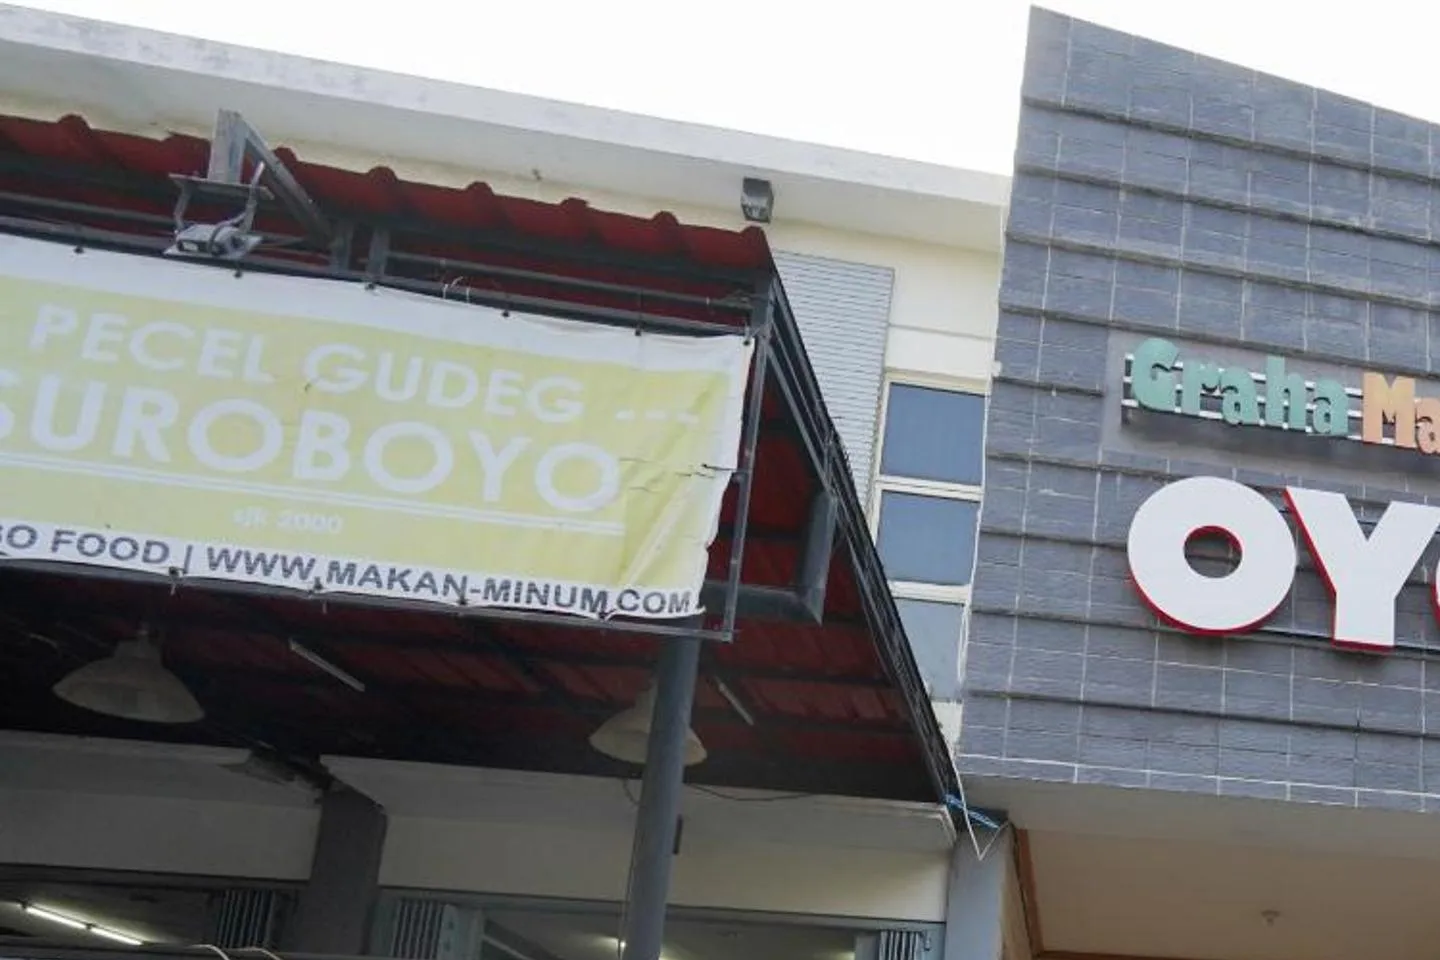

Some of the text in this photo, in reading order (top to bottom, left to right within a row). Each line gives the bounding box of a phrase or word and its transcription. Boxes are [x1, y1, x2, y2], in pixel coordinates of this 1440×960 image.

[29, 303, 276, 384] PECEL
[304, 342, 586, 424] GUDEG
[1128, 337, 1349, 438] Graha
[0, 524, 38, 550] O
[51, 528, 170, 565] FOOD
